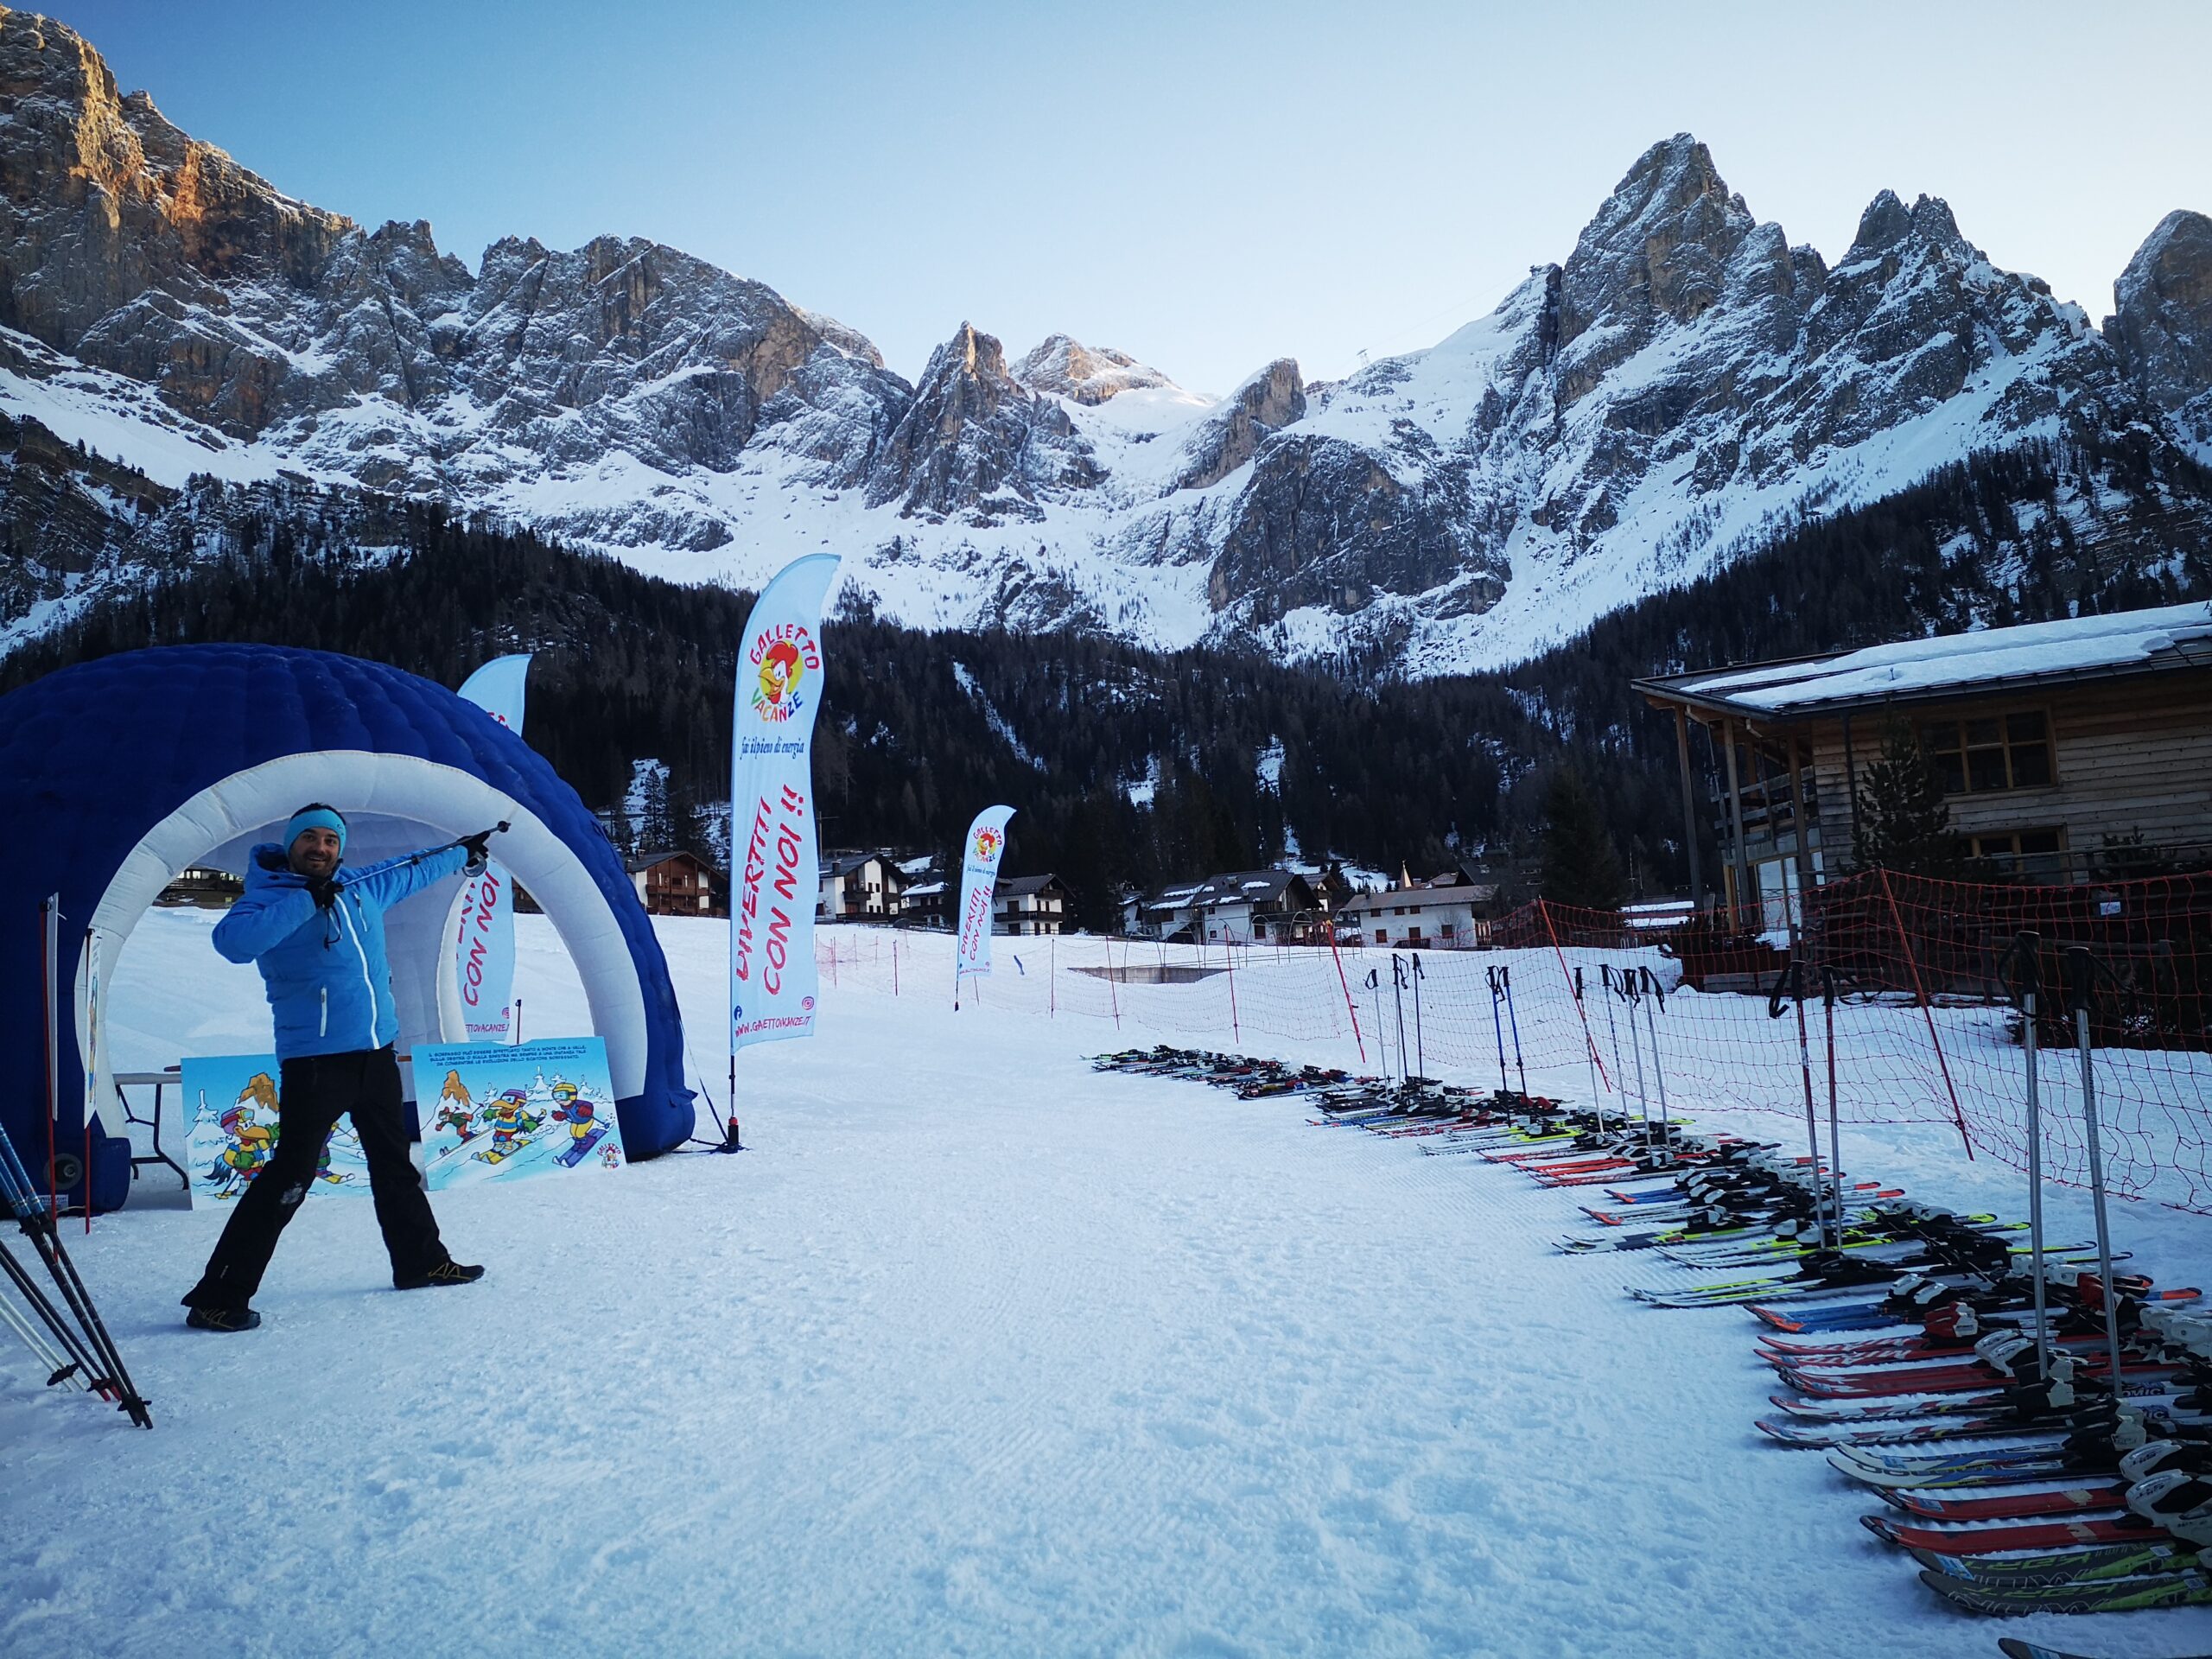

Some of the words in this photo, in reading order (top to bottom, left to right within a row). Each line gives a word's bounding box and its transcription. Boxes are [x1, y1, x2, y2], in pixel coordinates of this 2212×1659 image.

[750, 624, 819, 669] GALLETTO
[751, 687, 804, 722] VACANZE
[973, 826, 1002, 846] GALLETTO
[774, 823, 803, 901] NOI
[735, 796, 772, 981] DIVERTITI
[463, 935, 487, 1007] CON
[476, 870, 499, 933] NOI
[764, 906, 791, 995] CON
[969, 929, 980, 961] CON
[2102, 1388, 2162, 1399] AOMIC
